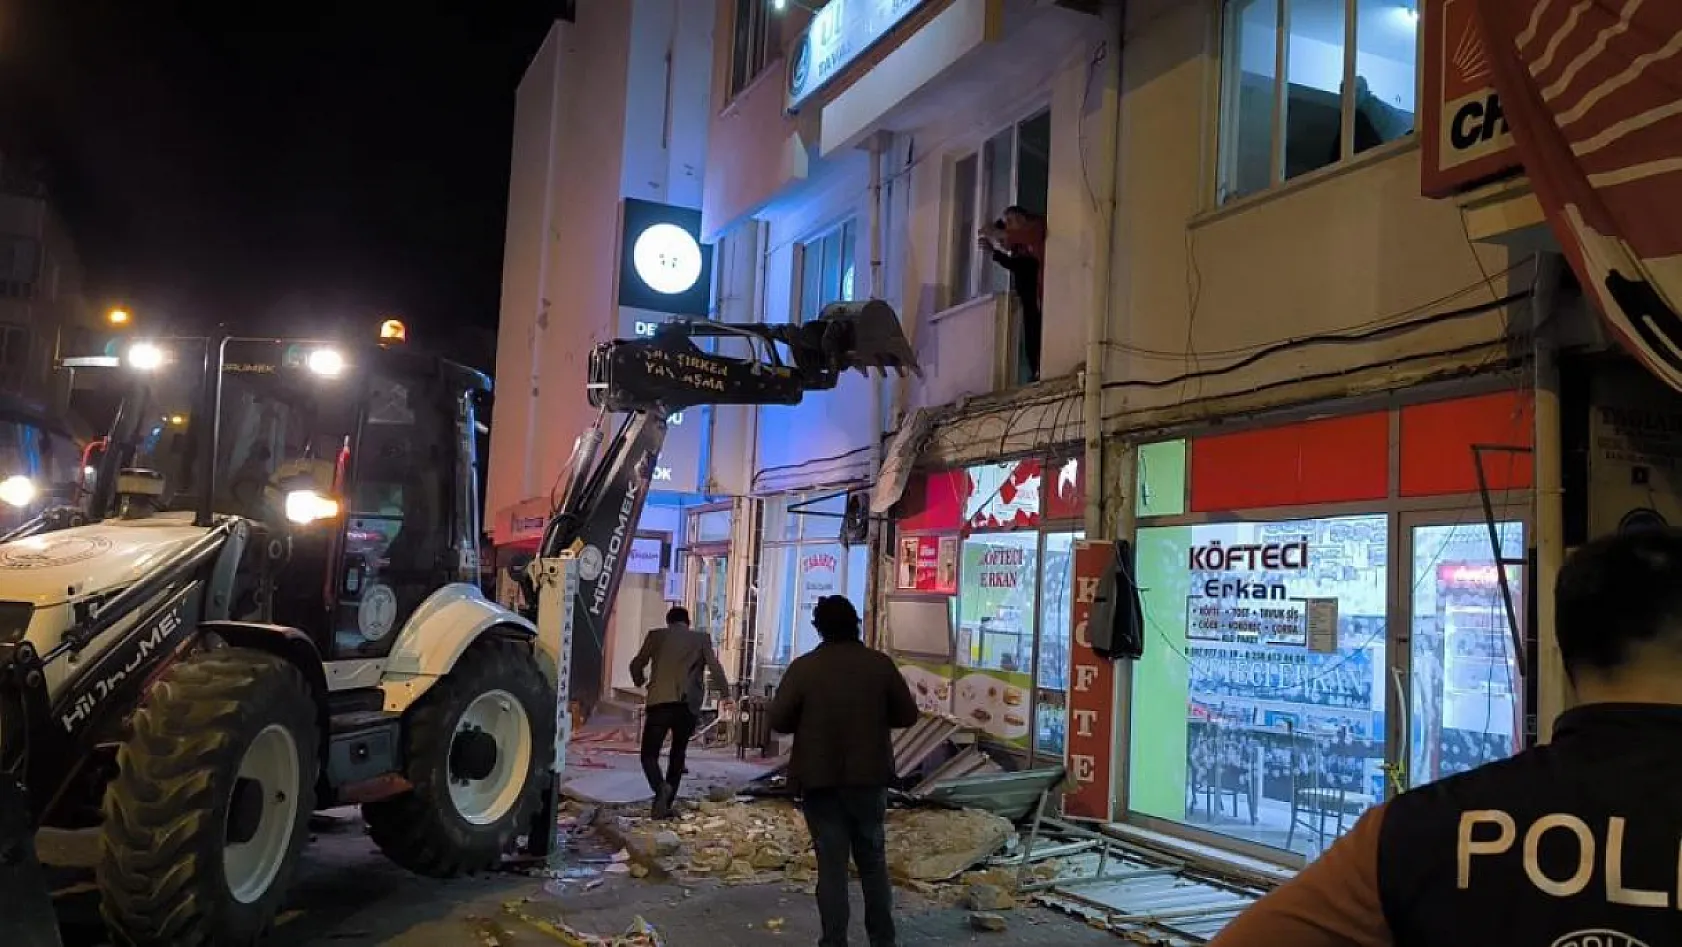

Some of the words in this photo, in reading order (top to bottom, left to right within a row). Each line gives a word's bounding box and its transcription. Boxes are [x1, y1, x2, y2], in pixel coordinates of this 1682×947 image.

[1451, 93, 1510, 150] CH
[1189, 535, 1308, 571] KÖFTECİ
[1205, 579, 1287, 600] Erkan
